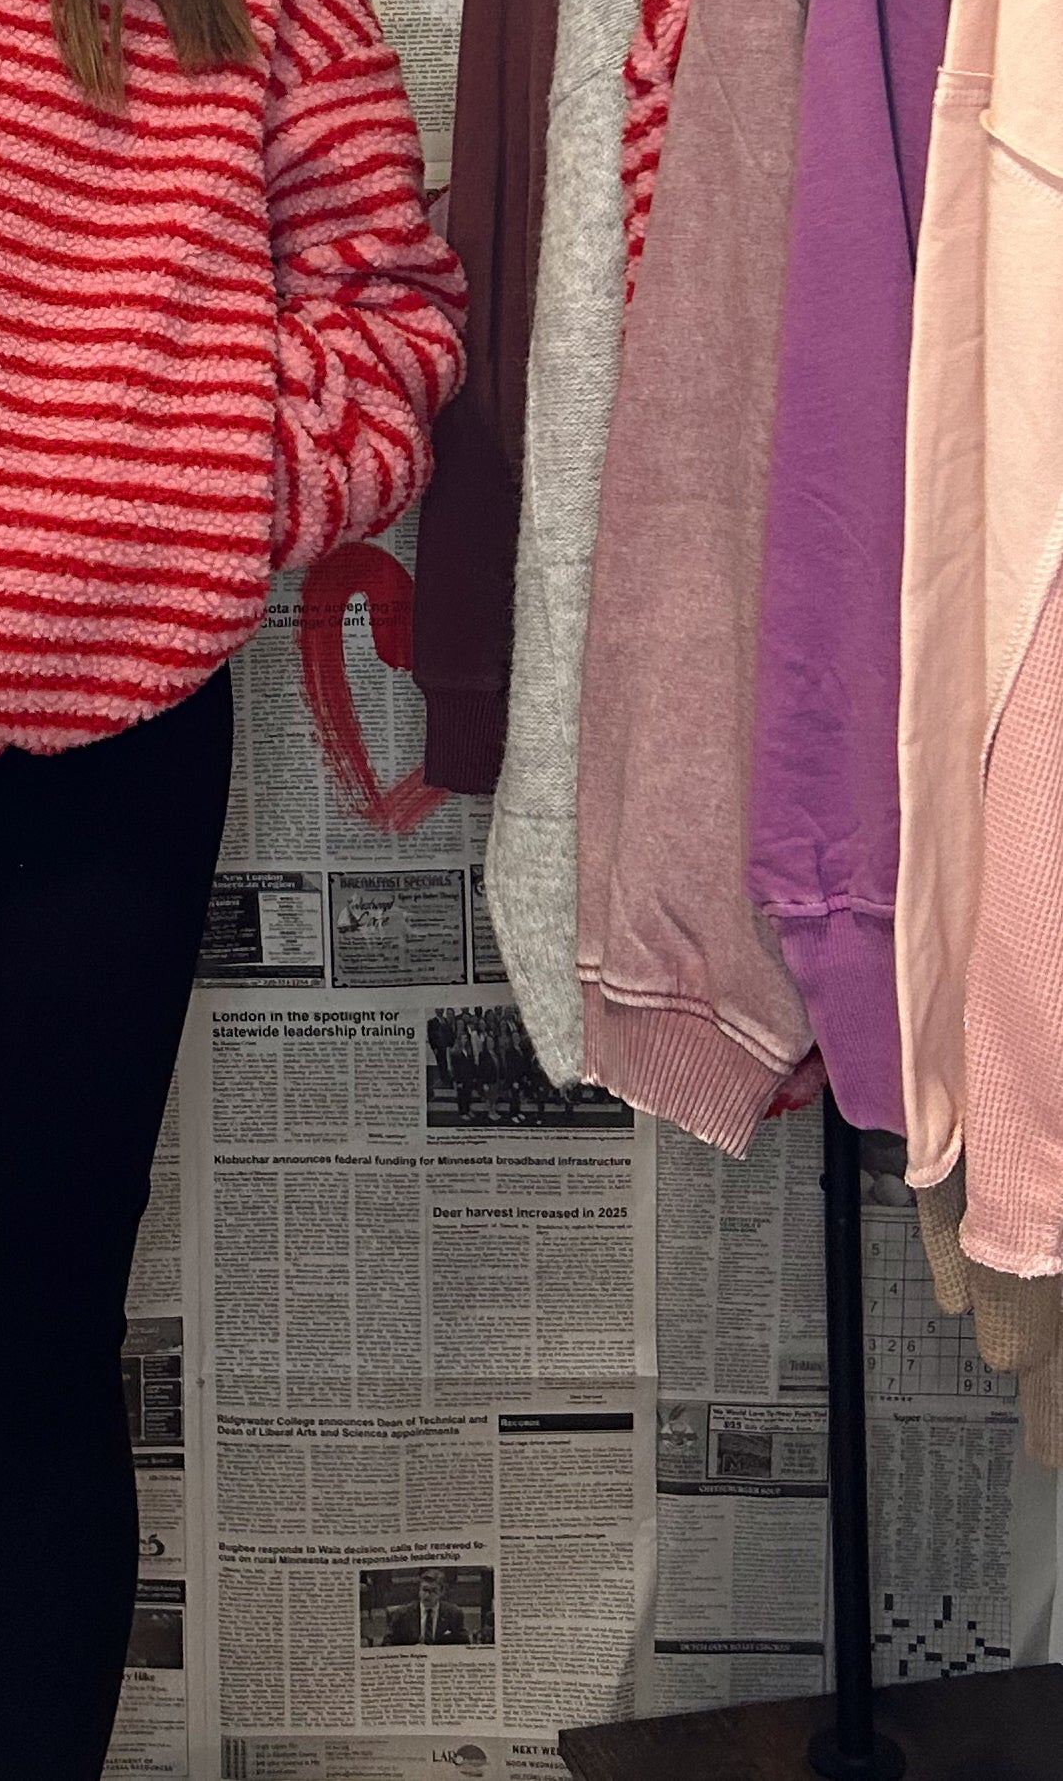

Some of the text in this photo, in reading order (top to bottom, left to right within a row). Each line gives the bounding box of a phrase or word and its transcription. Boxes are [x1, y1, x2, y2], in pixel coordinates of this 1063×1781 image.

[212, 1010, 399, 1024] London in the spotlight for
[212, 1022, 415, 1039] statewide leadership training
[432, 1206, 627, 1218] Deer harvest increased in 2025
